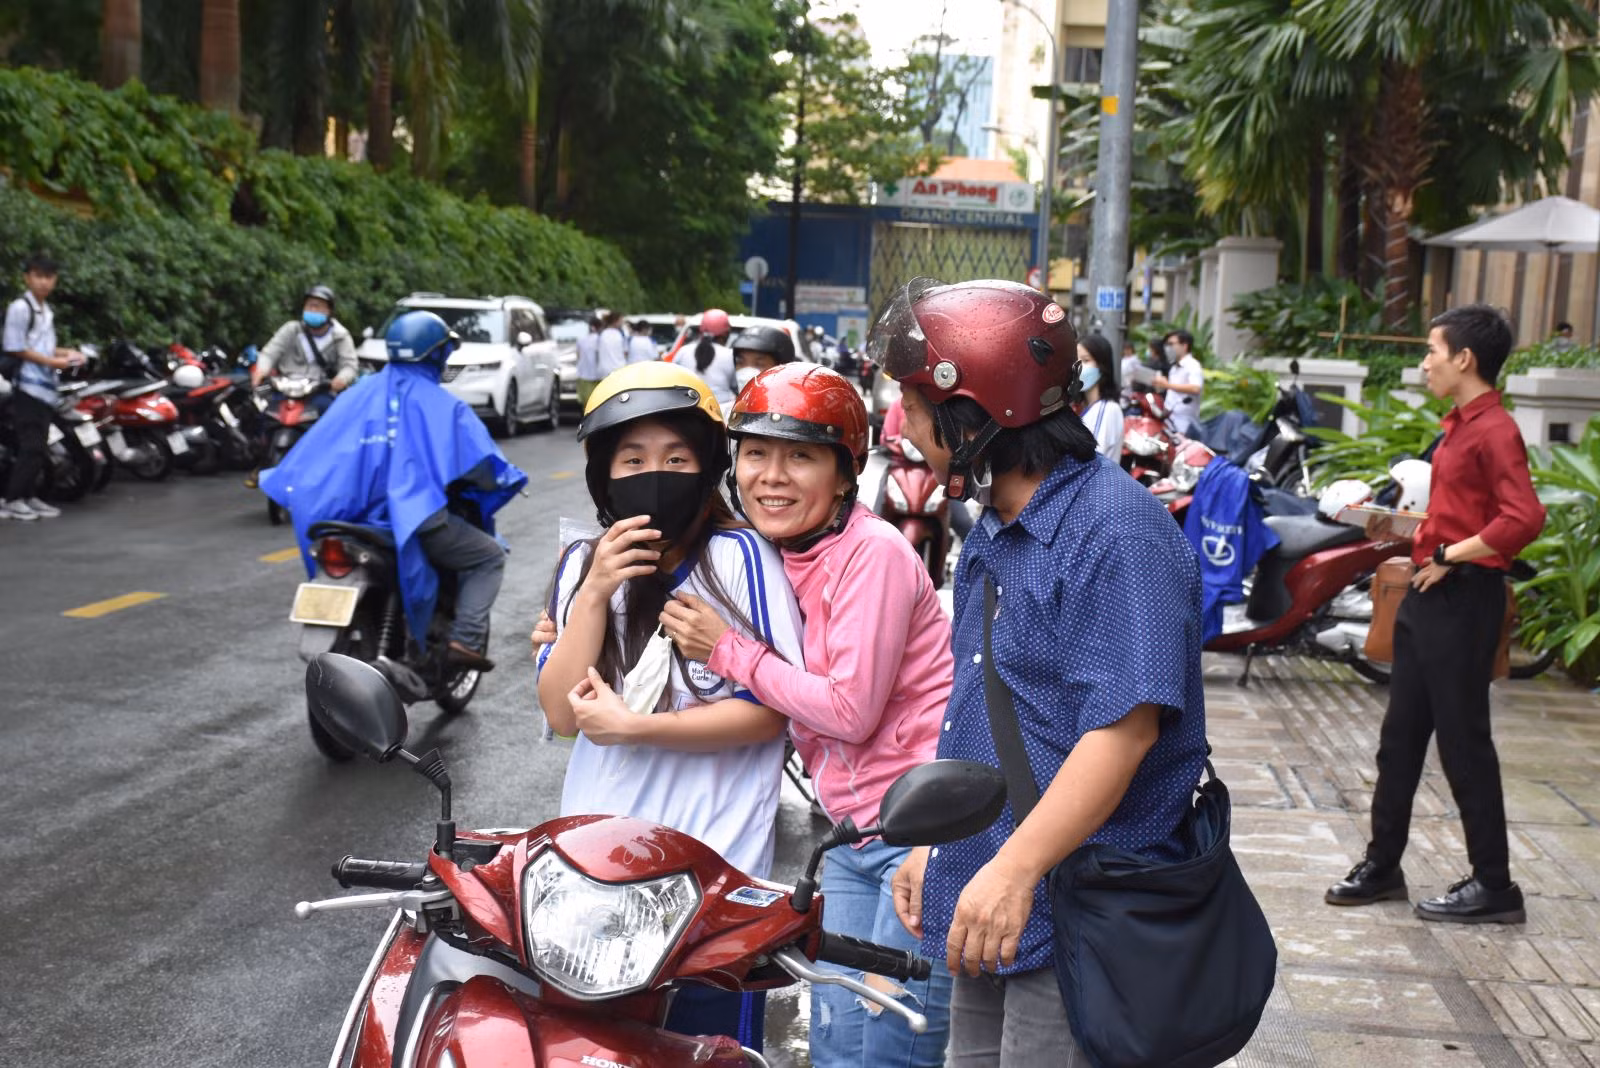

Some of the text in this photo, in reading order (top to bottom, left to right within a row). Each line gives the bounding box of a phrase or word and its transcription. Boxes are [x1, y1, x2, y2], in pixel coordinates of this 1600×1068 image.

[912, 178, 997, 204] An Phong
[955, 209, 1024, 225] CENTRAL
